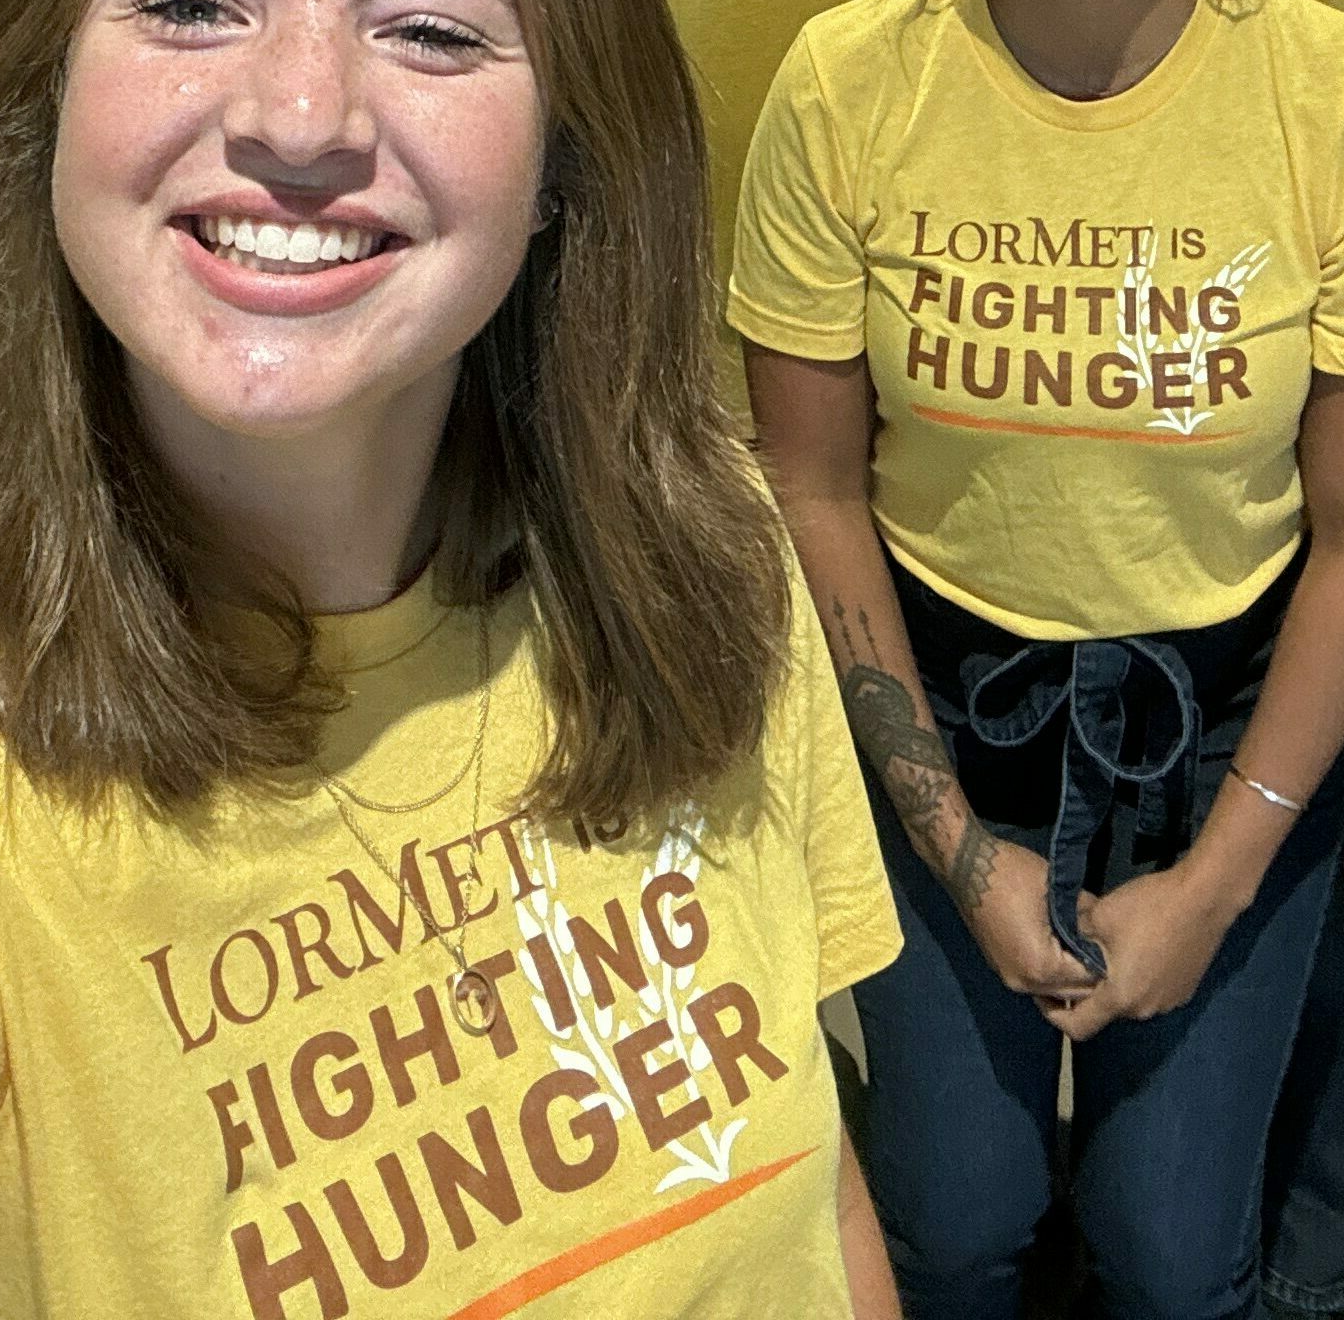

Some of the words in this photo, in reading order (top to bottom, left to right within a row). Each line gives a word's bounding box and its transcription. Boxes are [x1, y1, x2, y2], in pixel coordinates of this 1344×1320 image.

[1171, 227, 1207, 260] IS
[908, 267, 1242, 336] FIGHTING
[906, 326, 1252, 411] HUNGER
[206, 871, 710, 1194] FIGHTING
[230, 980, 791, 1320] HUNGER
